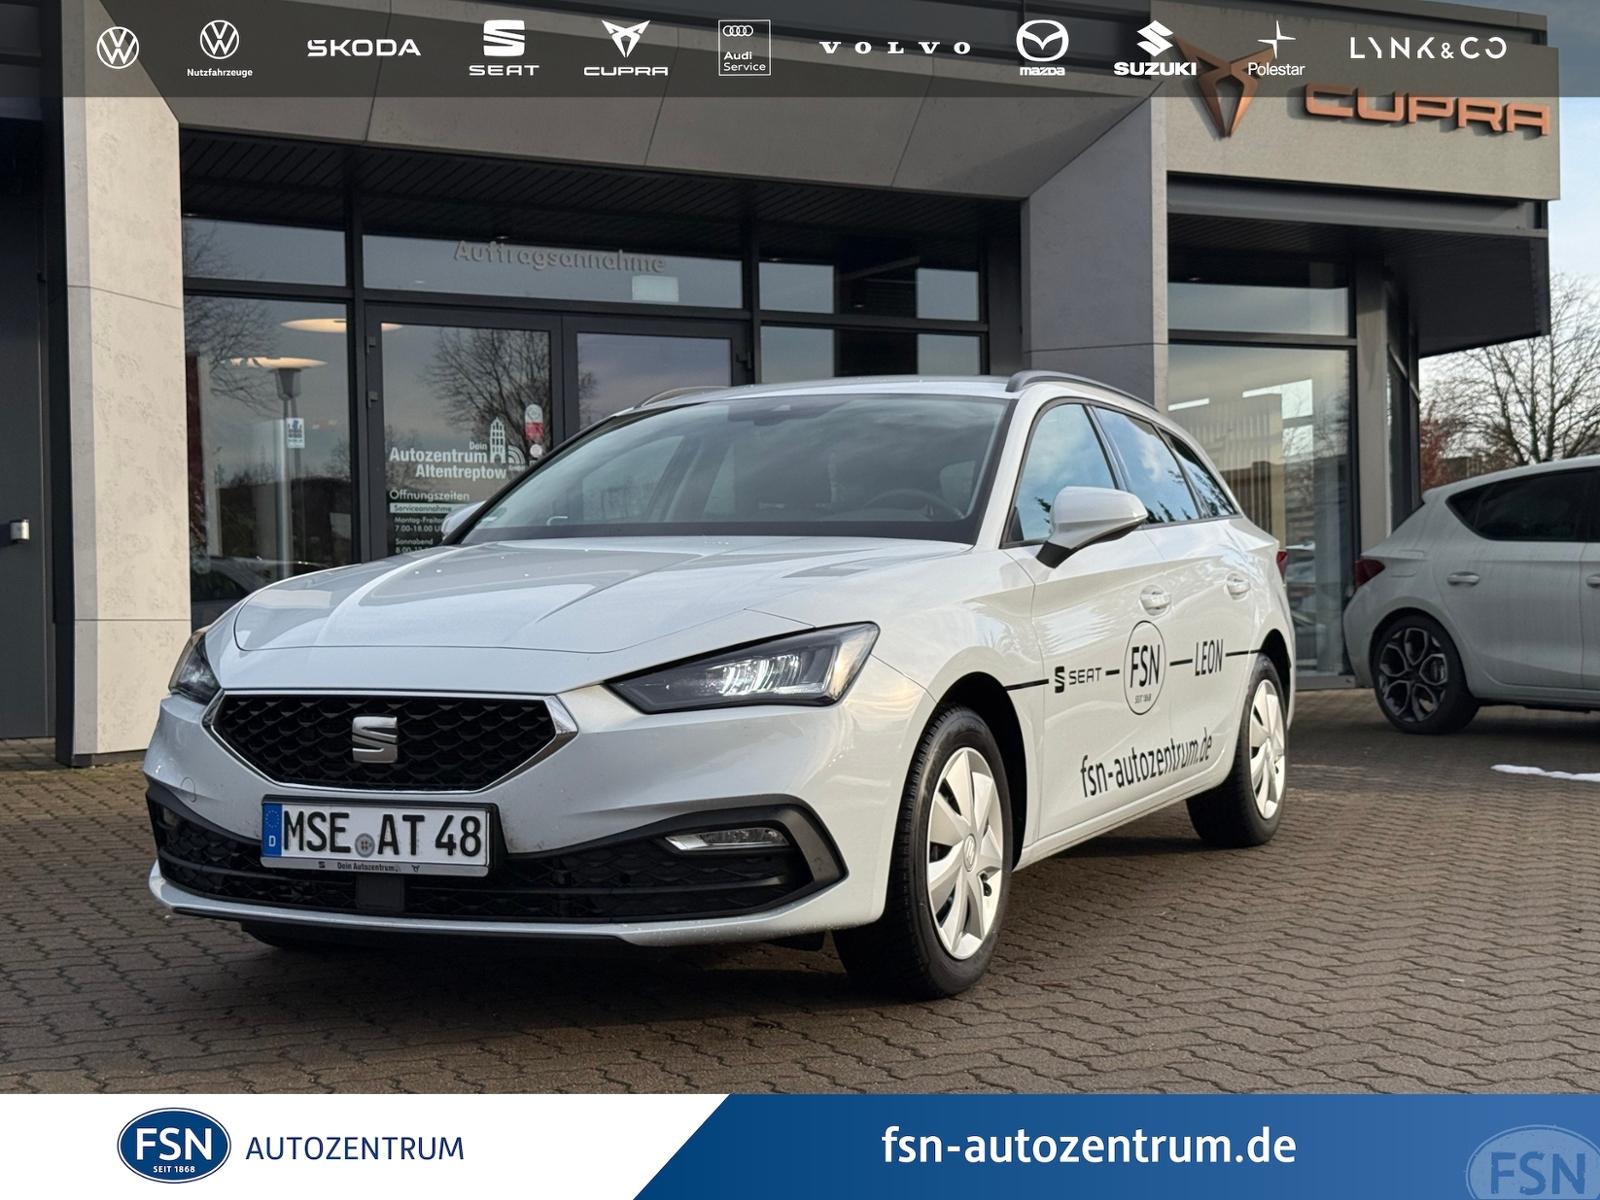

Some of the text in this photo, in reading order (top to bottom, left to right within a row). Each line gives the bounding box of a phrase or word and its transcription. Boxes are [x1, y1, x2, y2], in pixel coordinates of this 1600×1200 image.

[1305, 83, 1550, 136] CUPRA
[453, 240, 666, 273] Auftragsannahme
[389, 446, 488, 463] Autozentrum
[469, 440, 488, 451] Dein
[415, 464, 507, 482] Altentreptow
[389, 487, 470, 502] Öffnungszeiten
[394, 504, 452, 513] Serviceannahme
[1130, 644, 1161, 688] FSN
[1194, 639, 1224, 677] LEON
[1068, 667, 1102, 685] SEAT
[1080, 727, 1213, 798] fsn-autozentrum.de
[268, 835, 276, 848] D
[283, 810, 482, 858] MSE AT 48
[337, 862, 352, 870] Dein
